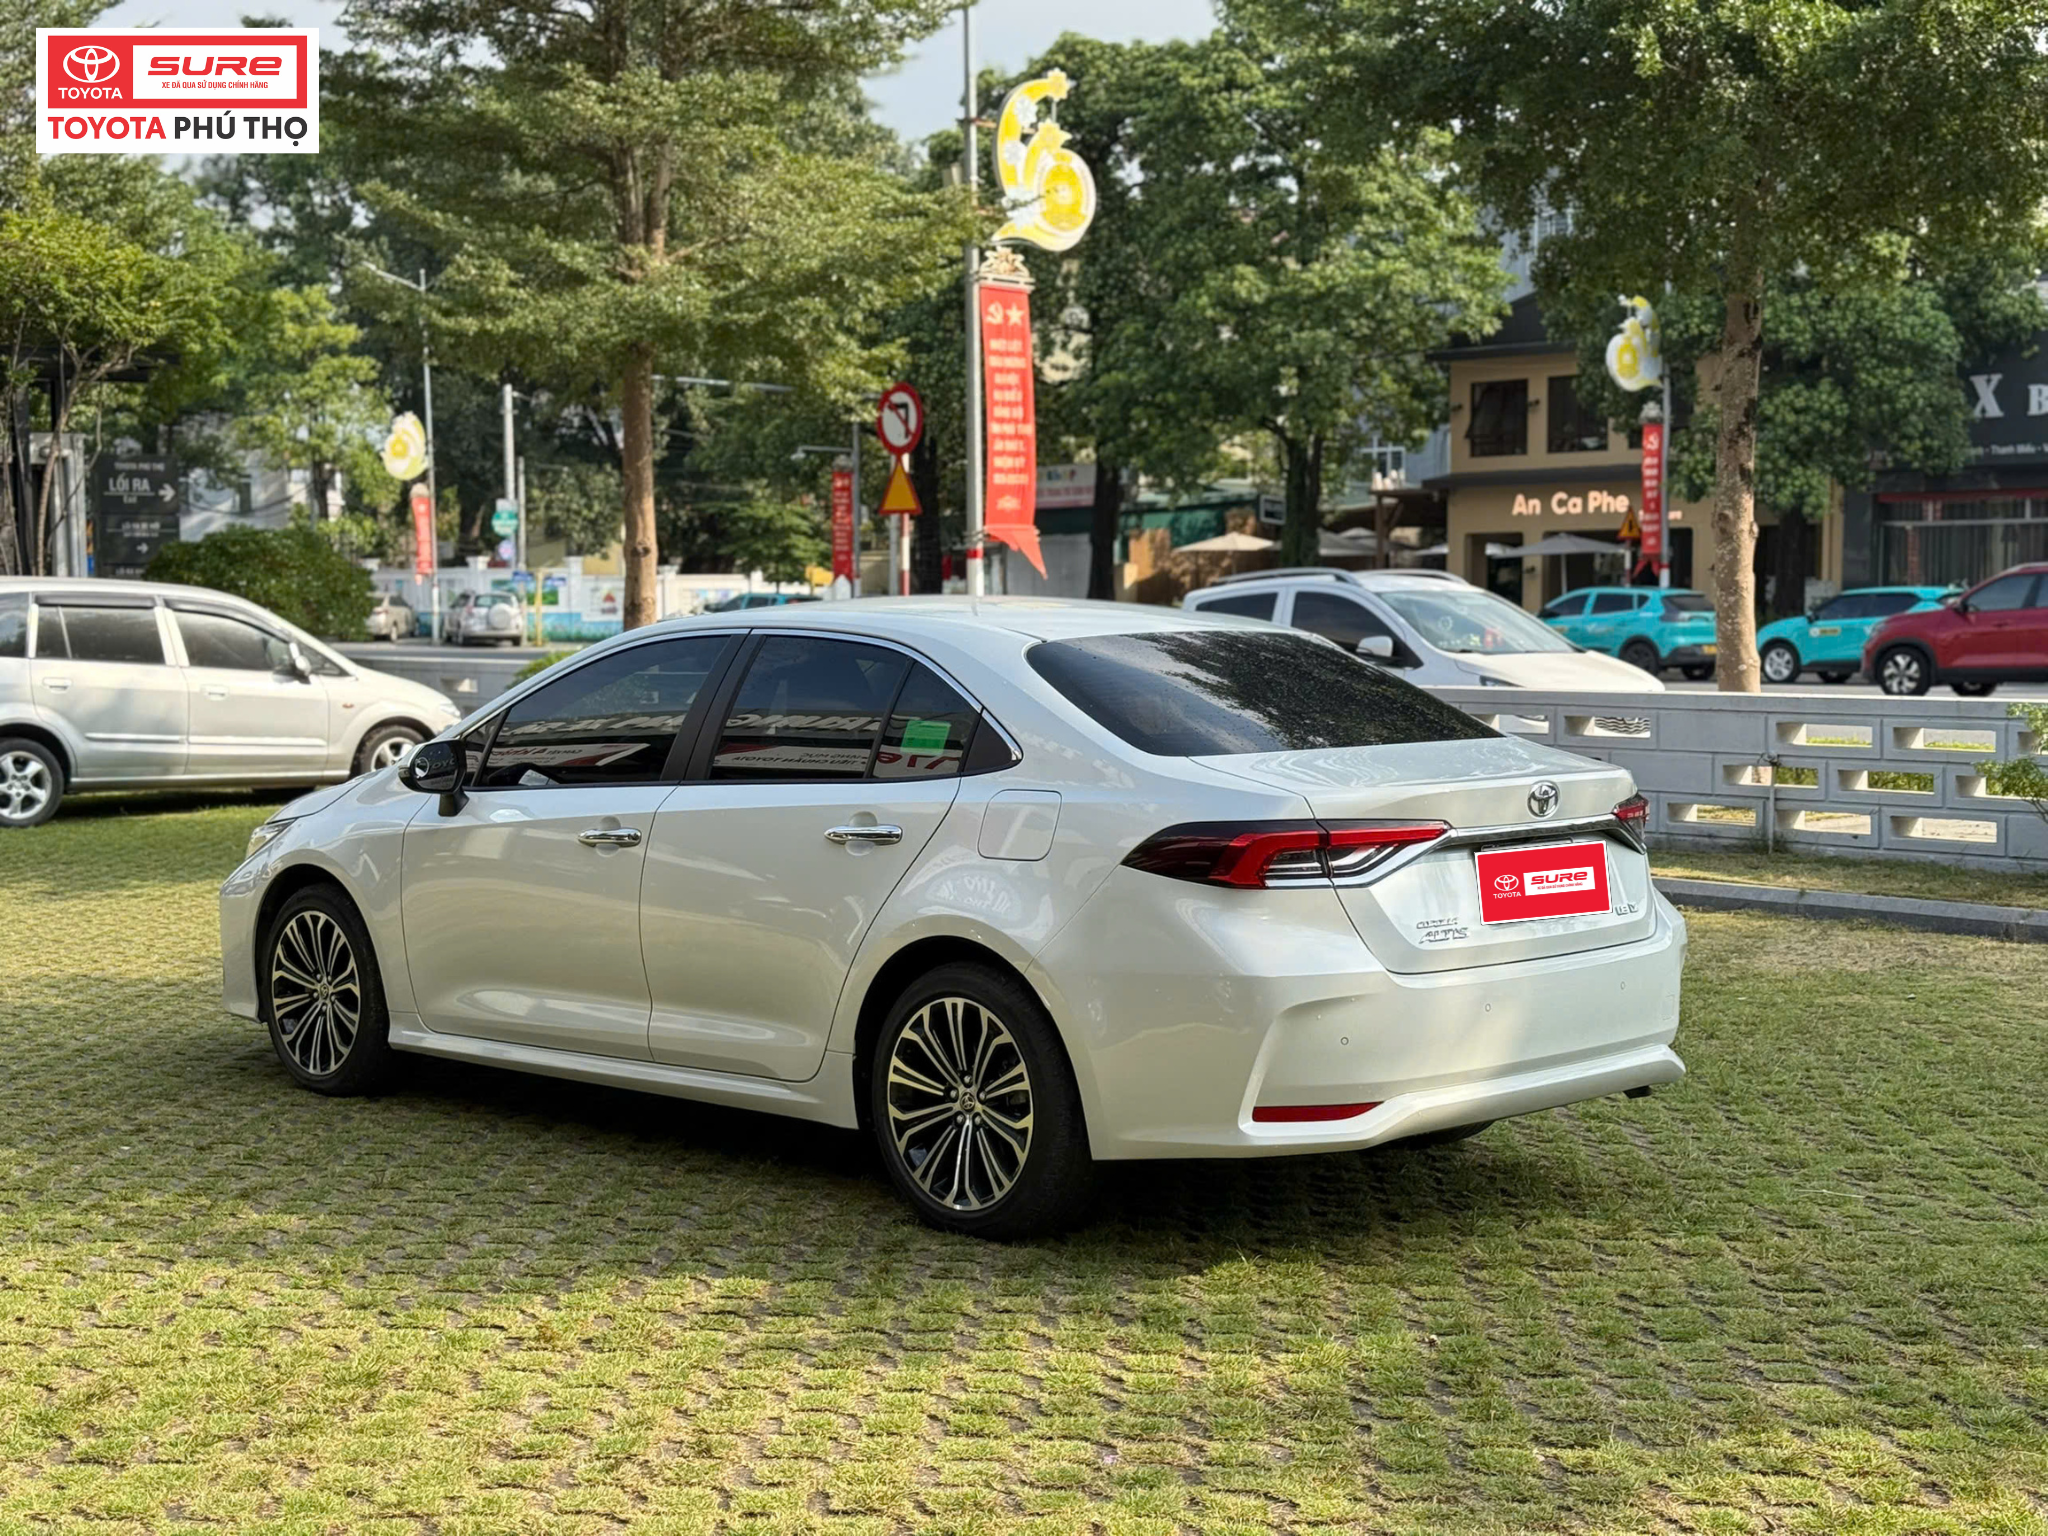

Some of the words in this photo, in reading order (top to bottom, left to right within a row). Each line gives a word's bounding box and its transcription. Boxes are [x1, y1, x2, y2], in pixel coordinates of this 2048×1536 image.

[109, 472, 130, 492] LỐI
[132, 478, 151, 492] RA
[1512, 494, 1542, 516] An
[1551, 491, 1583, 515] Ca
[1587, 490, 1630, 514] Phe
